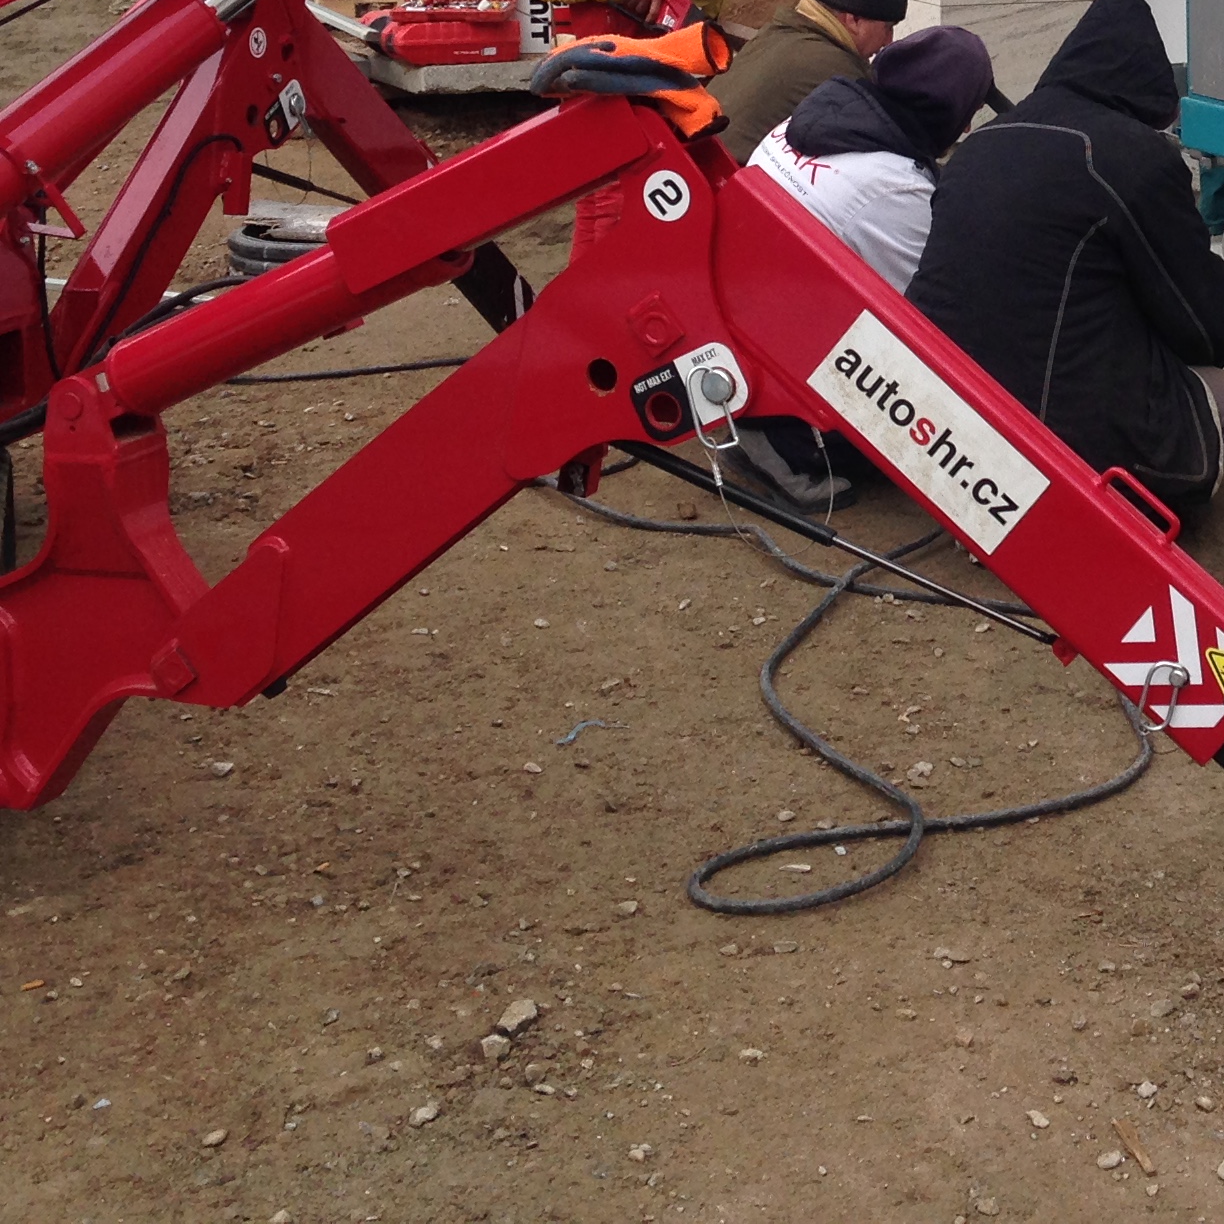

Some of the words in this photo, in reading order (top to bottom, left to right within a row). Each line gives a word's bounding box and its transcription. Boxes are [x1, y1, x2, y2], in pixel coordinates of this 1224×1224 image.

[647, 178, 683, 217] 2
[691, 354, 706, 367] MAX
[834, 348, 1020, 526] autoshr.cz
